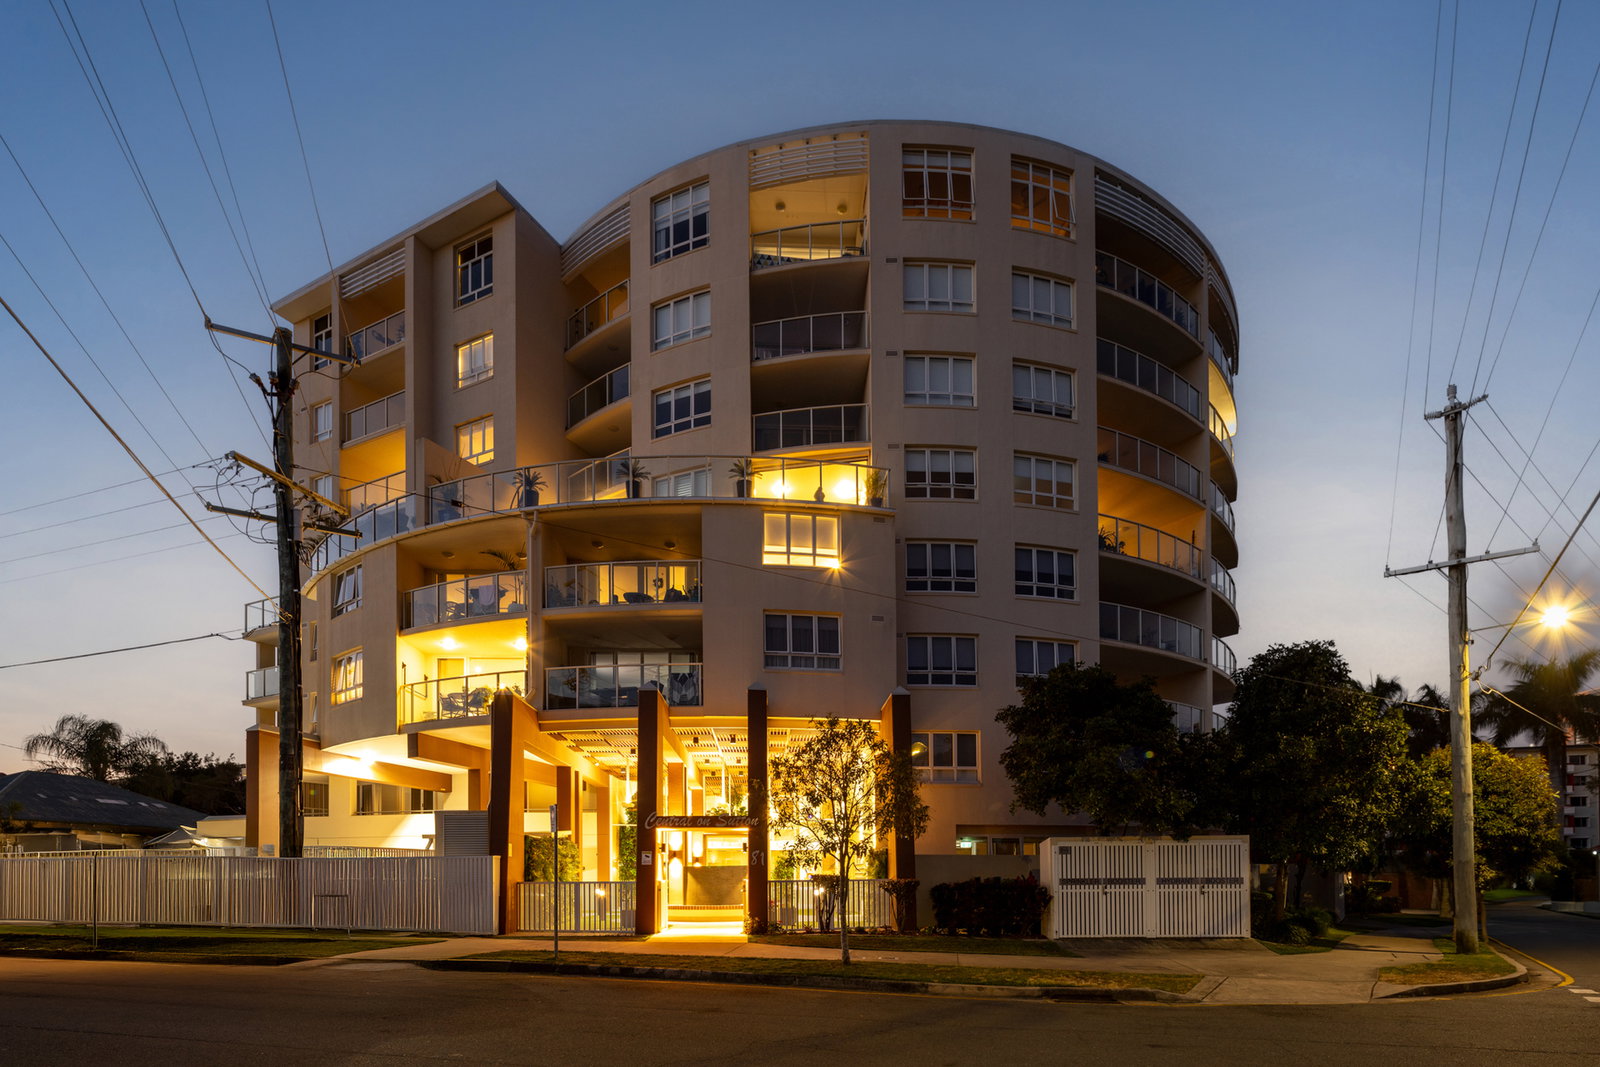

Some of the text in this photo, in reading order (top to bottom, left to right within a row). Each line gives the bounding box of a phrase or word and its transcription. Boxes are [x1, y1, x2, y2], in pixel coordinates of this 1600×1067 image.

[644, 811, 760, 829] Central on Sutton
[750, 849, 765, 866] 81
